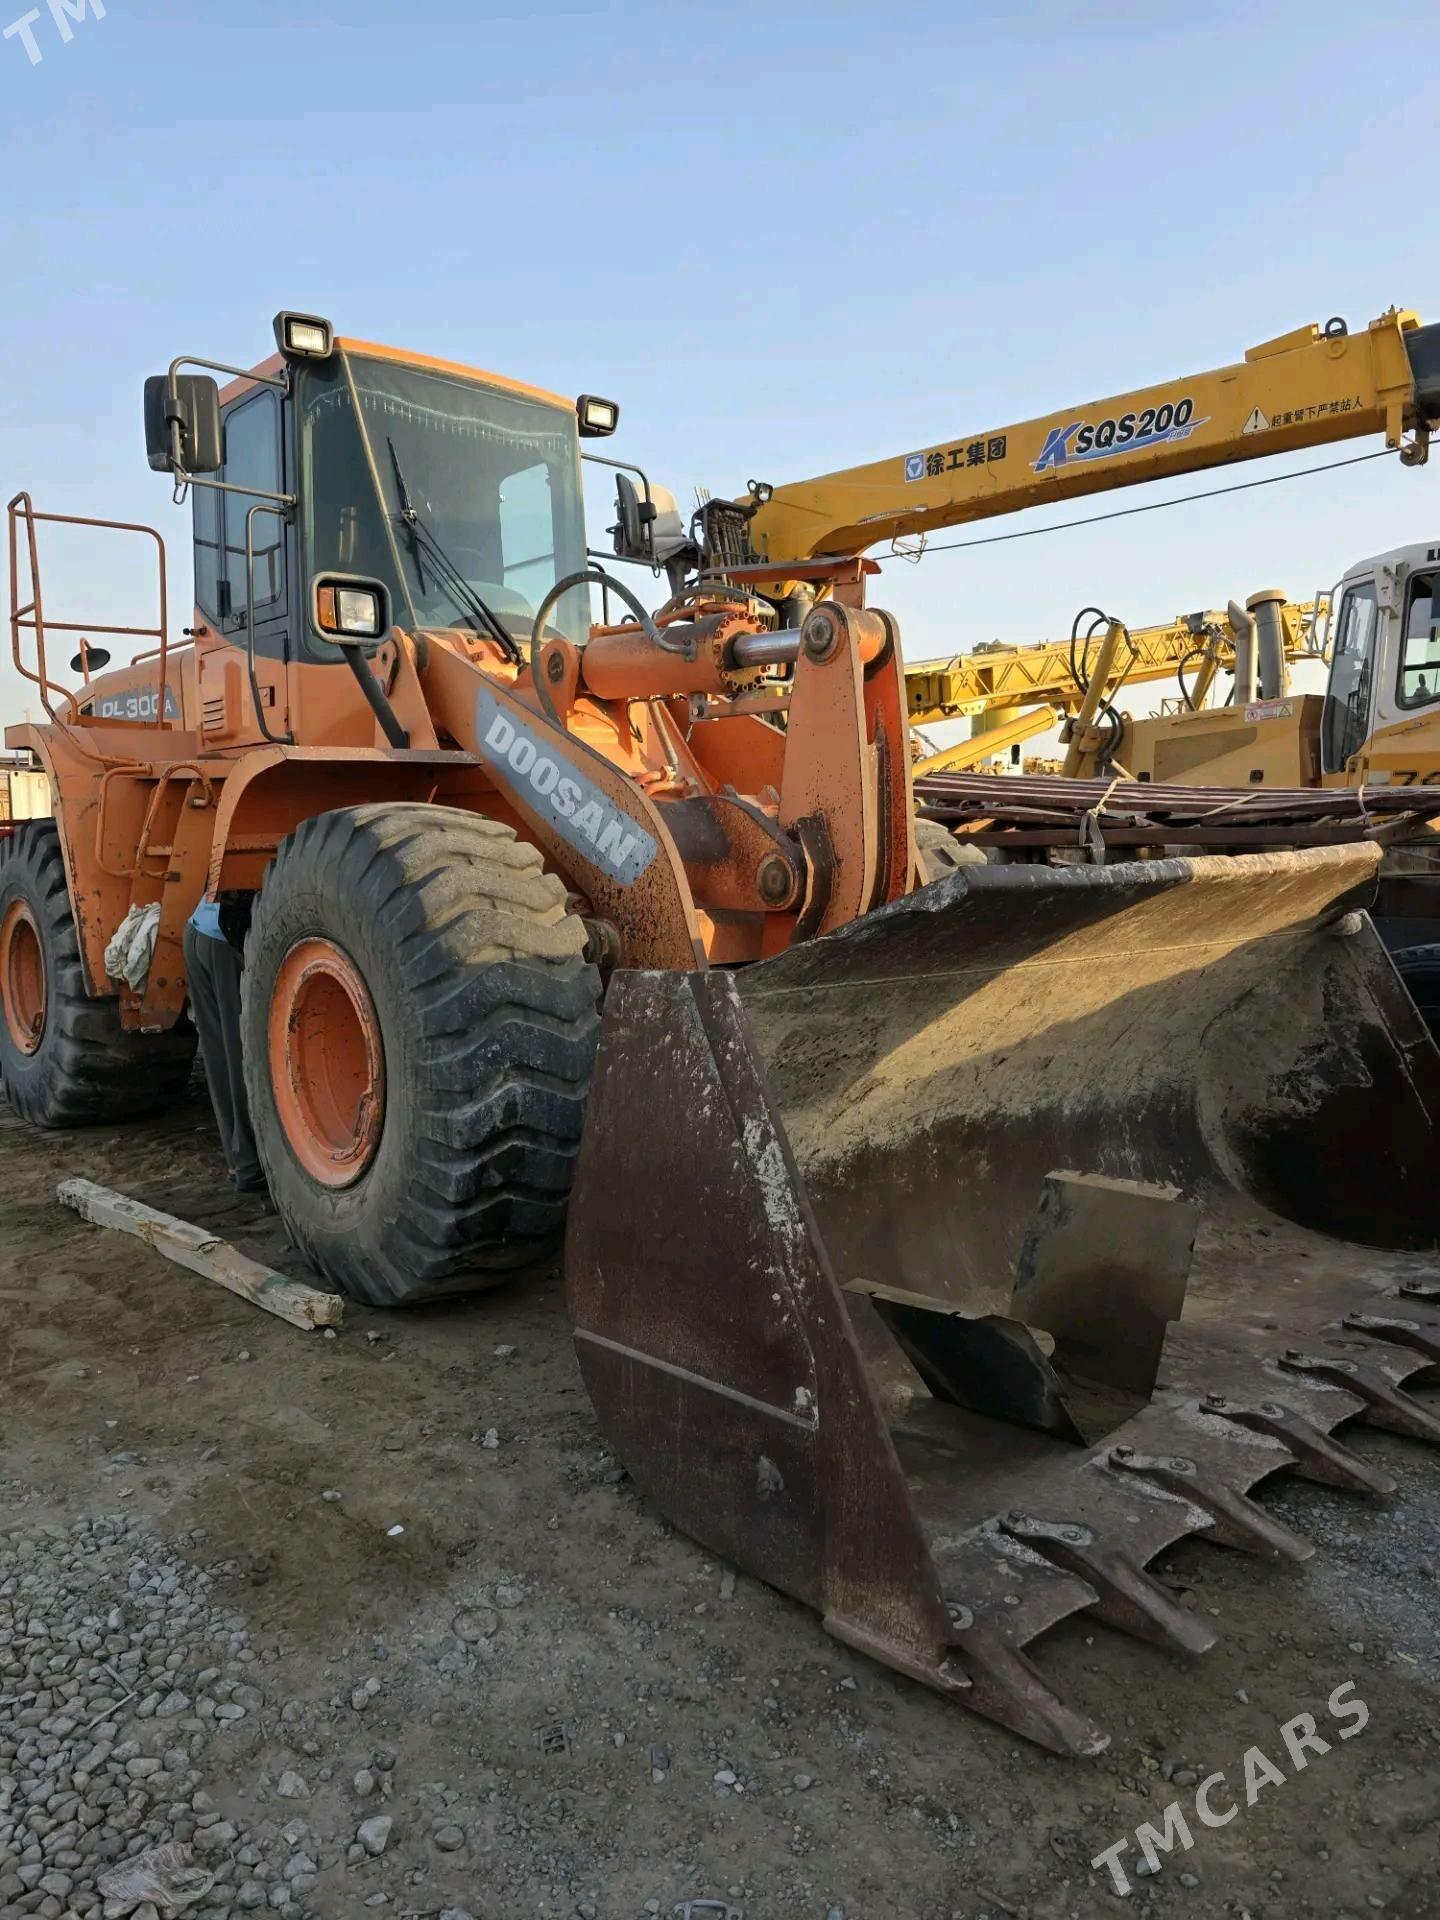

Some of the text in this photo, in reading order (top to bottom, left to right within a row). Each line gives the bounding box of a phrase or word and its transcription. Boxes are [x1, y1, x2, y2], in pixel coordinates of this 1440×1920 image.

[926, 435, 1006, 477] 徐工集团
[484, 713, 637, 867] DOOSAN
